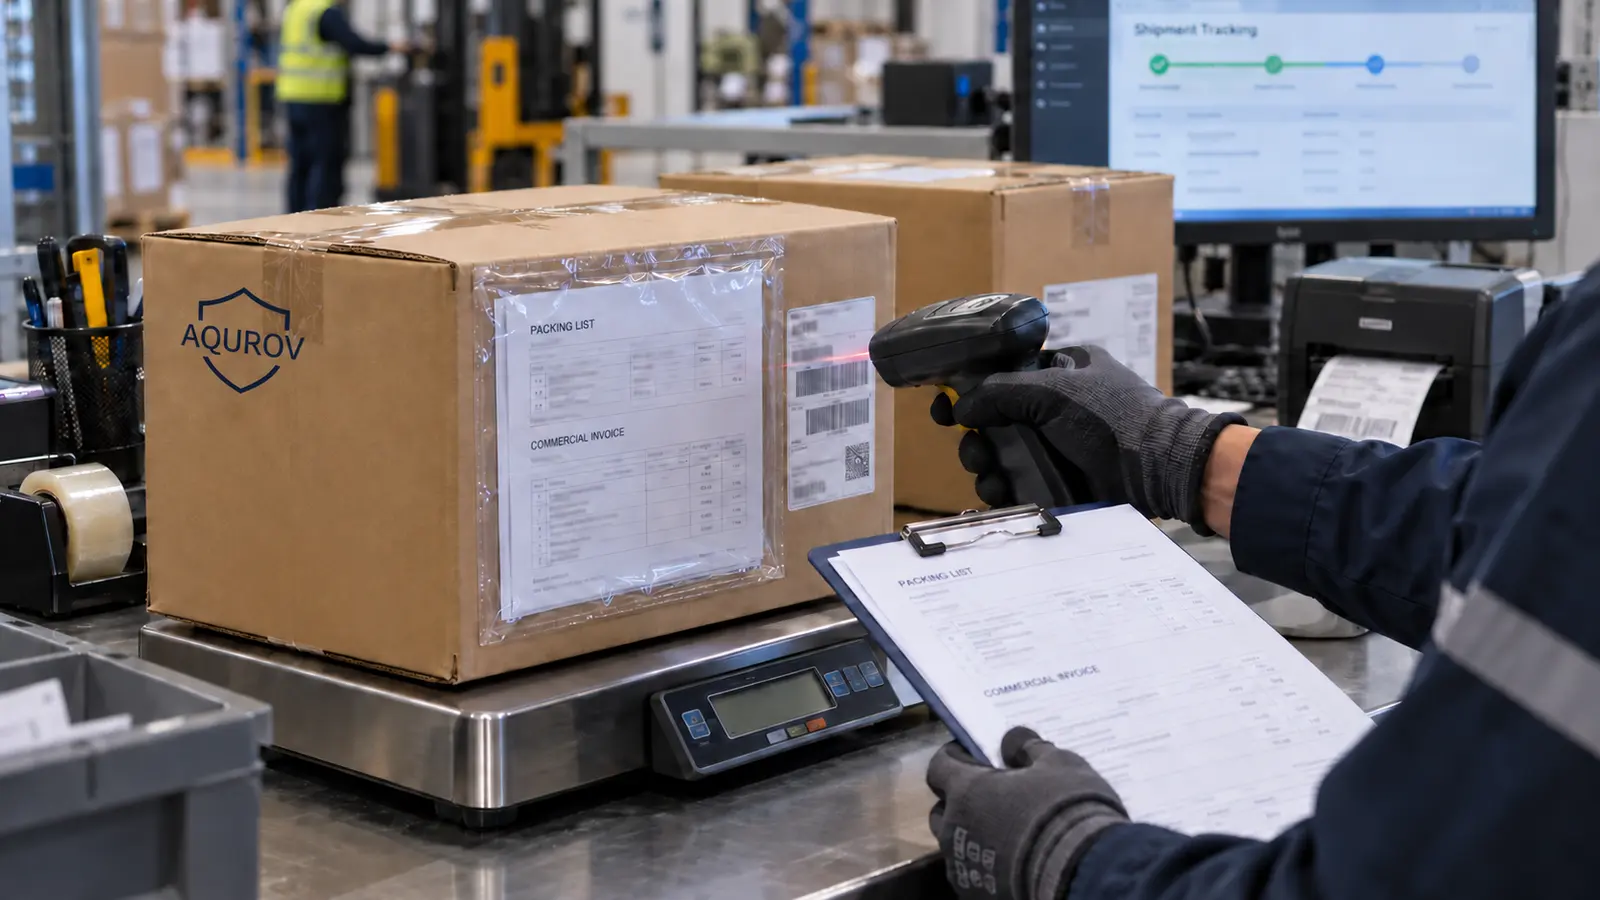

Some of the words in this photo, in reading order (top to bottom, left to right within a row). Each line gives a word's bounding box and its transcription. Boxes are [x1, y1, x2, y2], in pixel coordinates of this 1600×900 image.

[1134, 23, 1197, 38] Shipment
[1200, 23, 1258, 38] Tracking
[530, 321, 573, 335] PACKING
[575, 319, 596, 331] LIST
[181, 323, 304, 360] AQUROV
[530, 433, 589, 451] COMMERCIAL
[590, 427, 625, 442] INVOICE
[897, 571, 949, 589] PACKING
[949, 566, 974, 580] LIST
[983, 674, 1057, 699] COMMERCIAL
[1057, 664, 1101, 682] INVOICE
